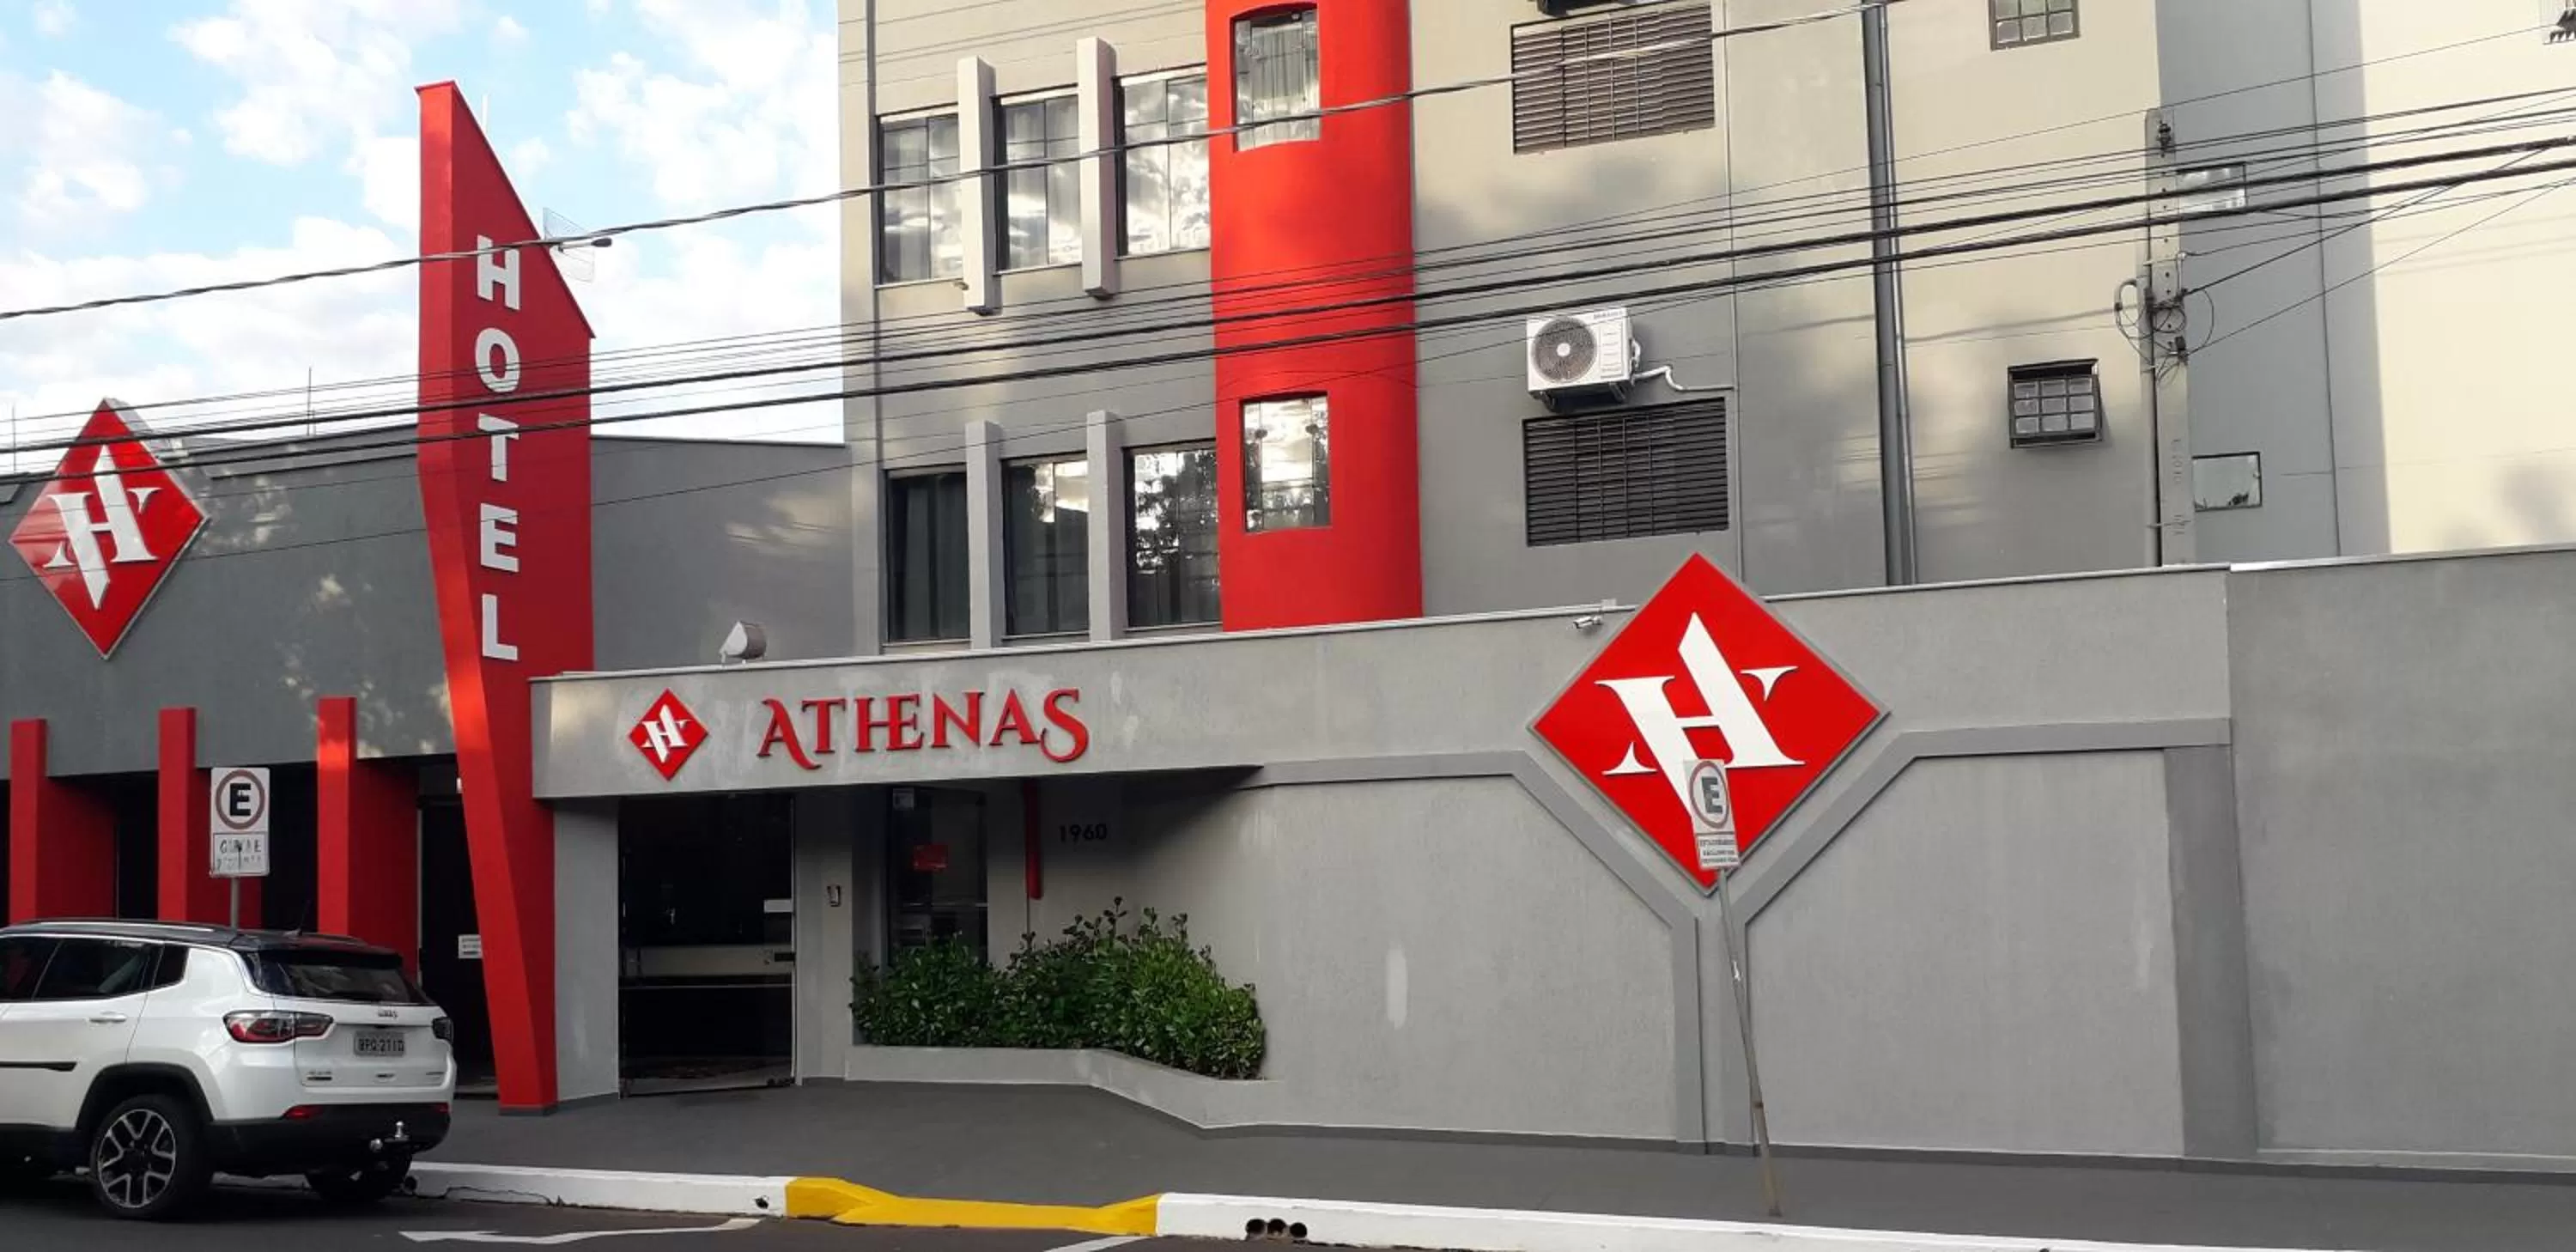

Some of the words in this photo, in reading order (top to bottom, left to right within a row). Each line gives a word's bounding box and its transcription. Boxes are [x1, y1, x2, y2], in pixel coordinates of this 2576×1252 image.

[475, 234, 521, 661] HOTEL
[757, 688, 1089, 770] ATHENAS
[229, 782, 252, 817] E
[1701, 776, 1723, 814] E
[1058, 824, 1108, 844] 1960
